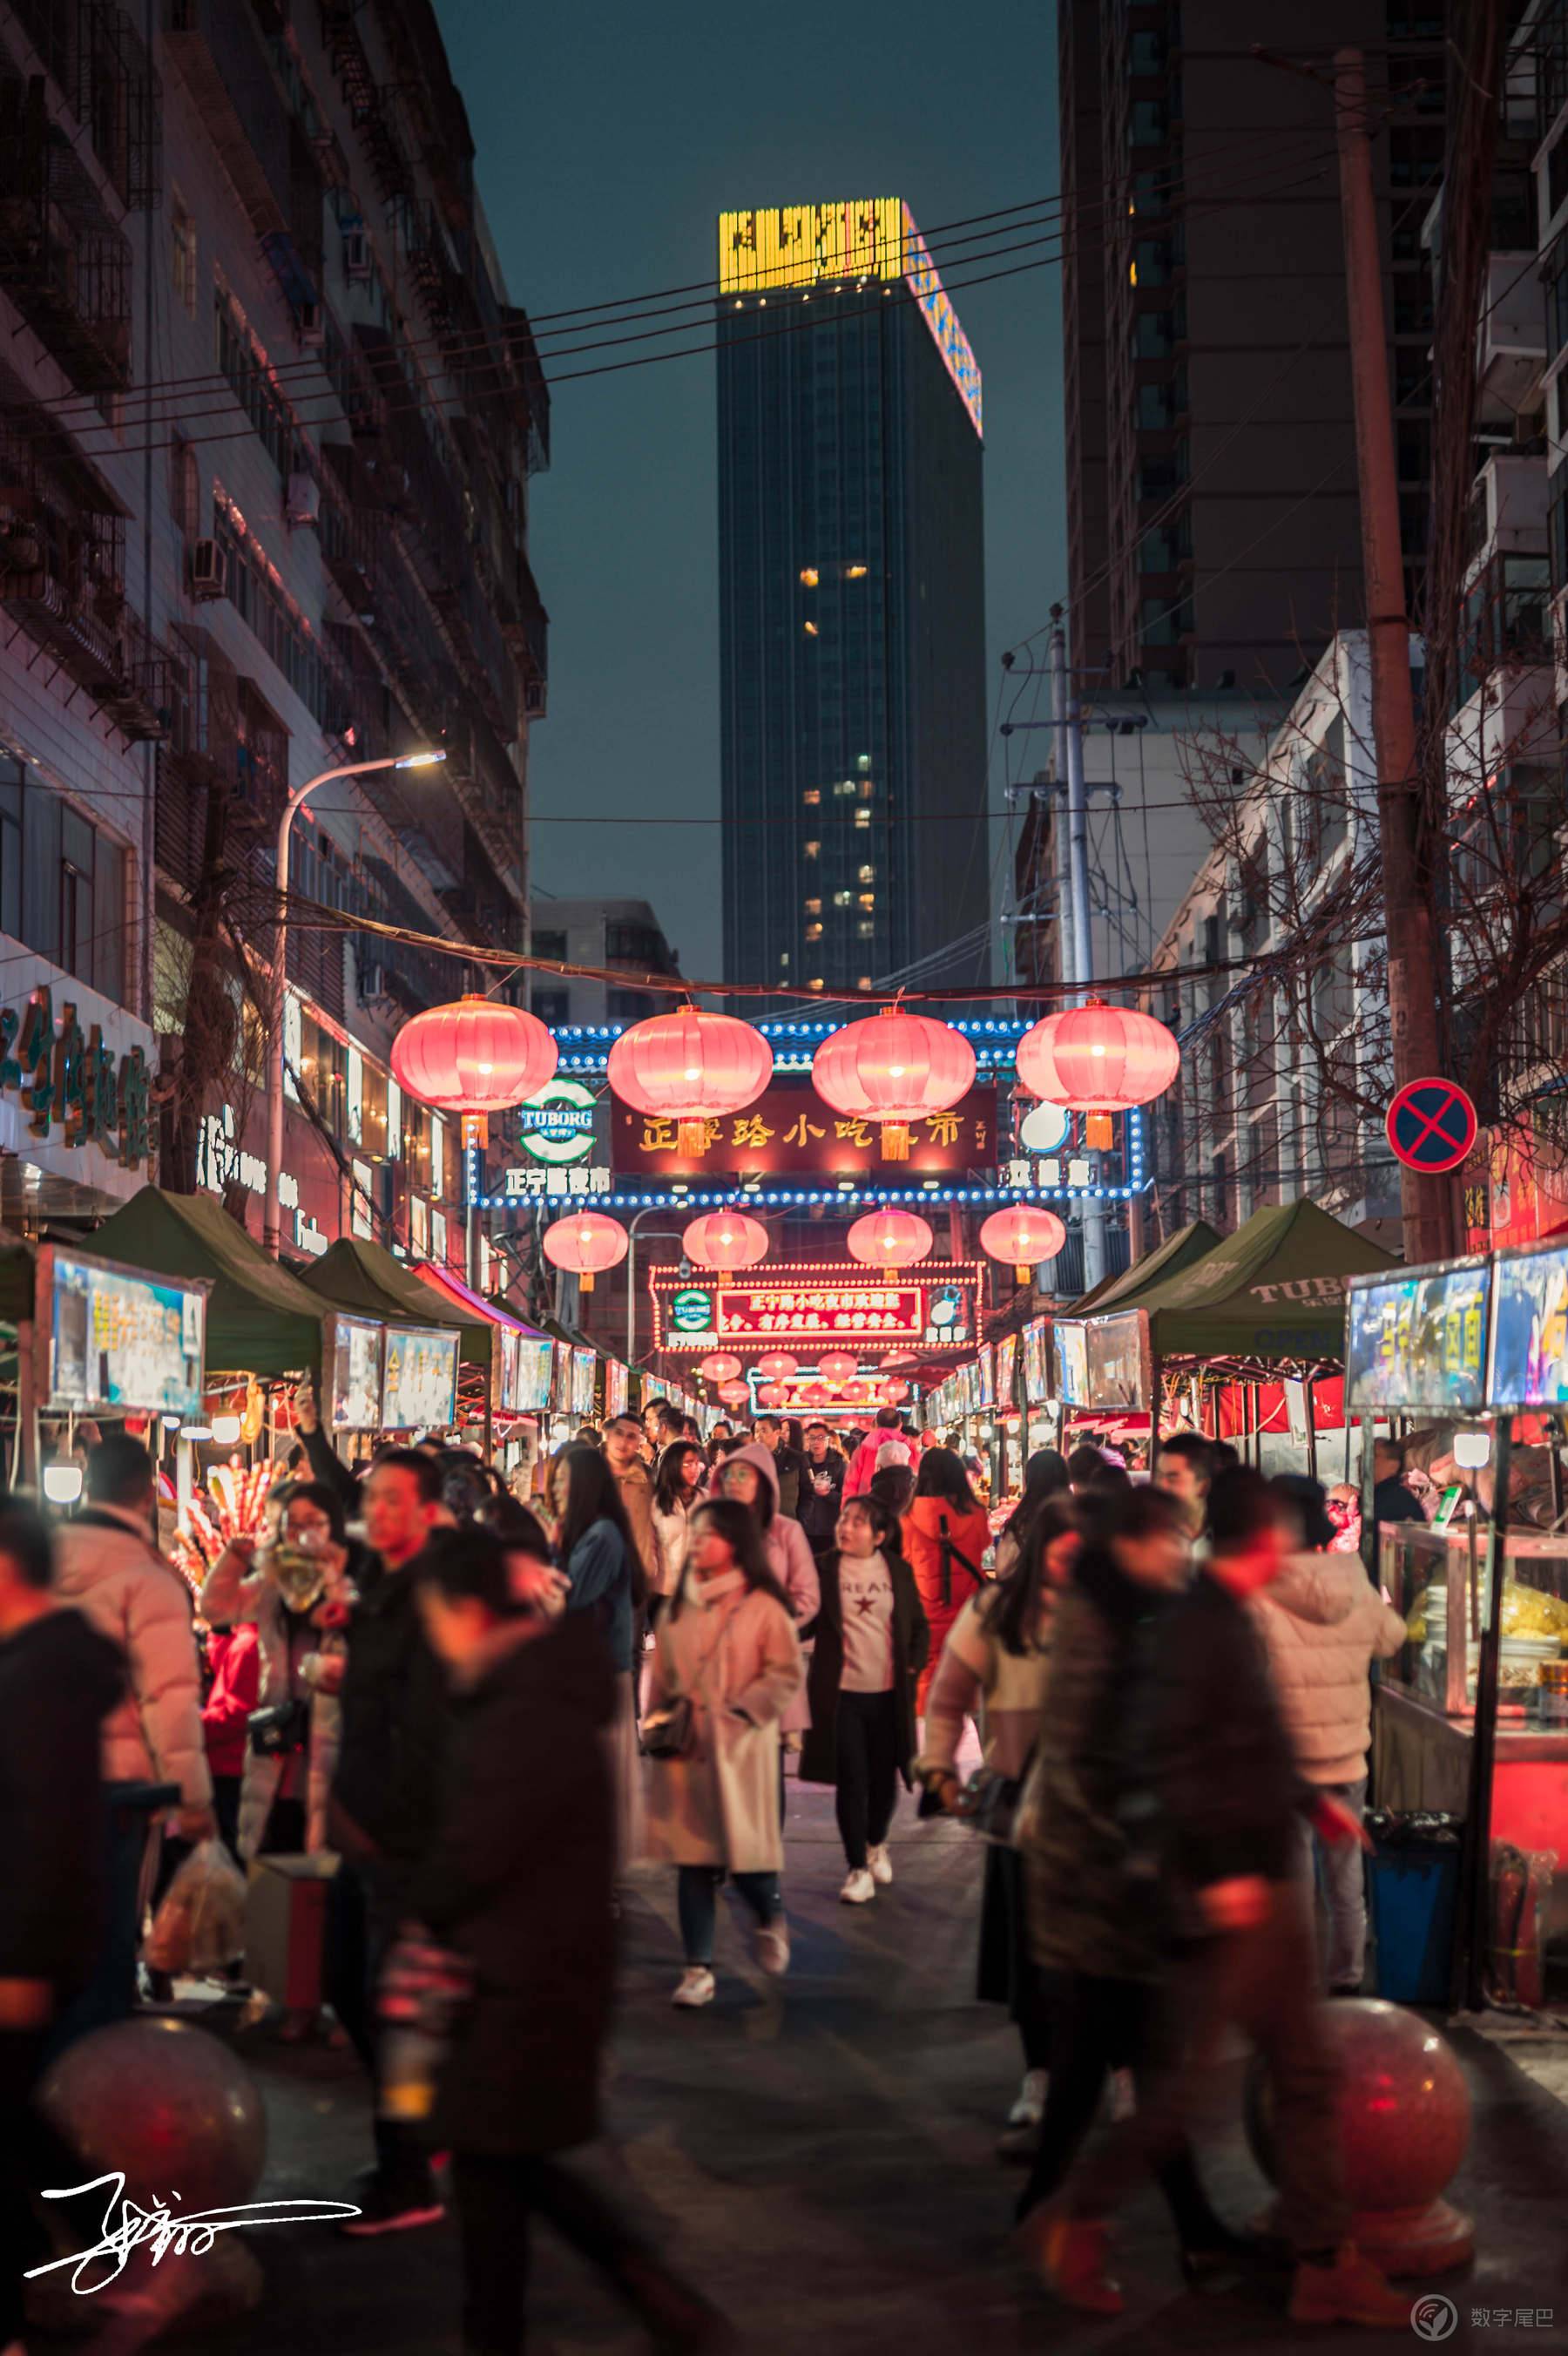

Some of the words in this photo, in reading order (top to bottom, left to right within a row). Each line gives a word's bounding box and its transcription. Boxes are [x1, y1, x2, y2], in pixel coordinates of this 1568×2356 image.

[521, 1110, 592, 1128] TUBORG
[639, 1111, 965, 1153] 正路小吃市
